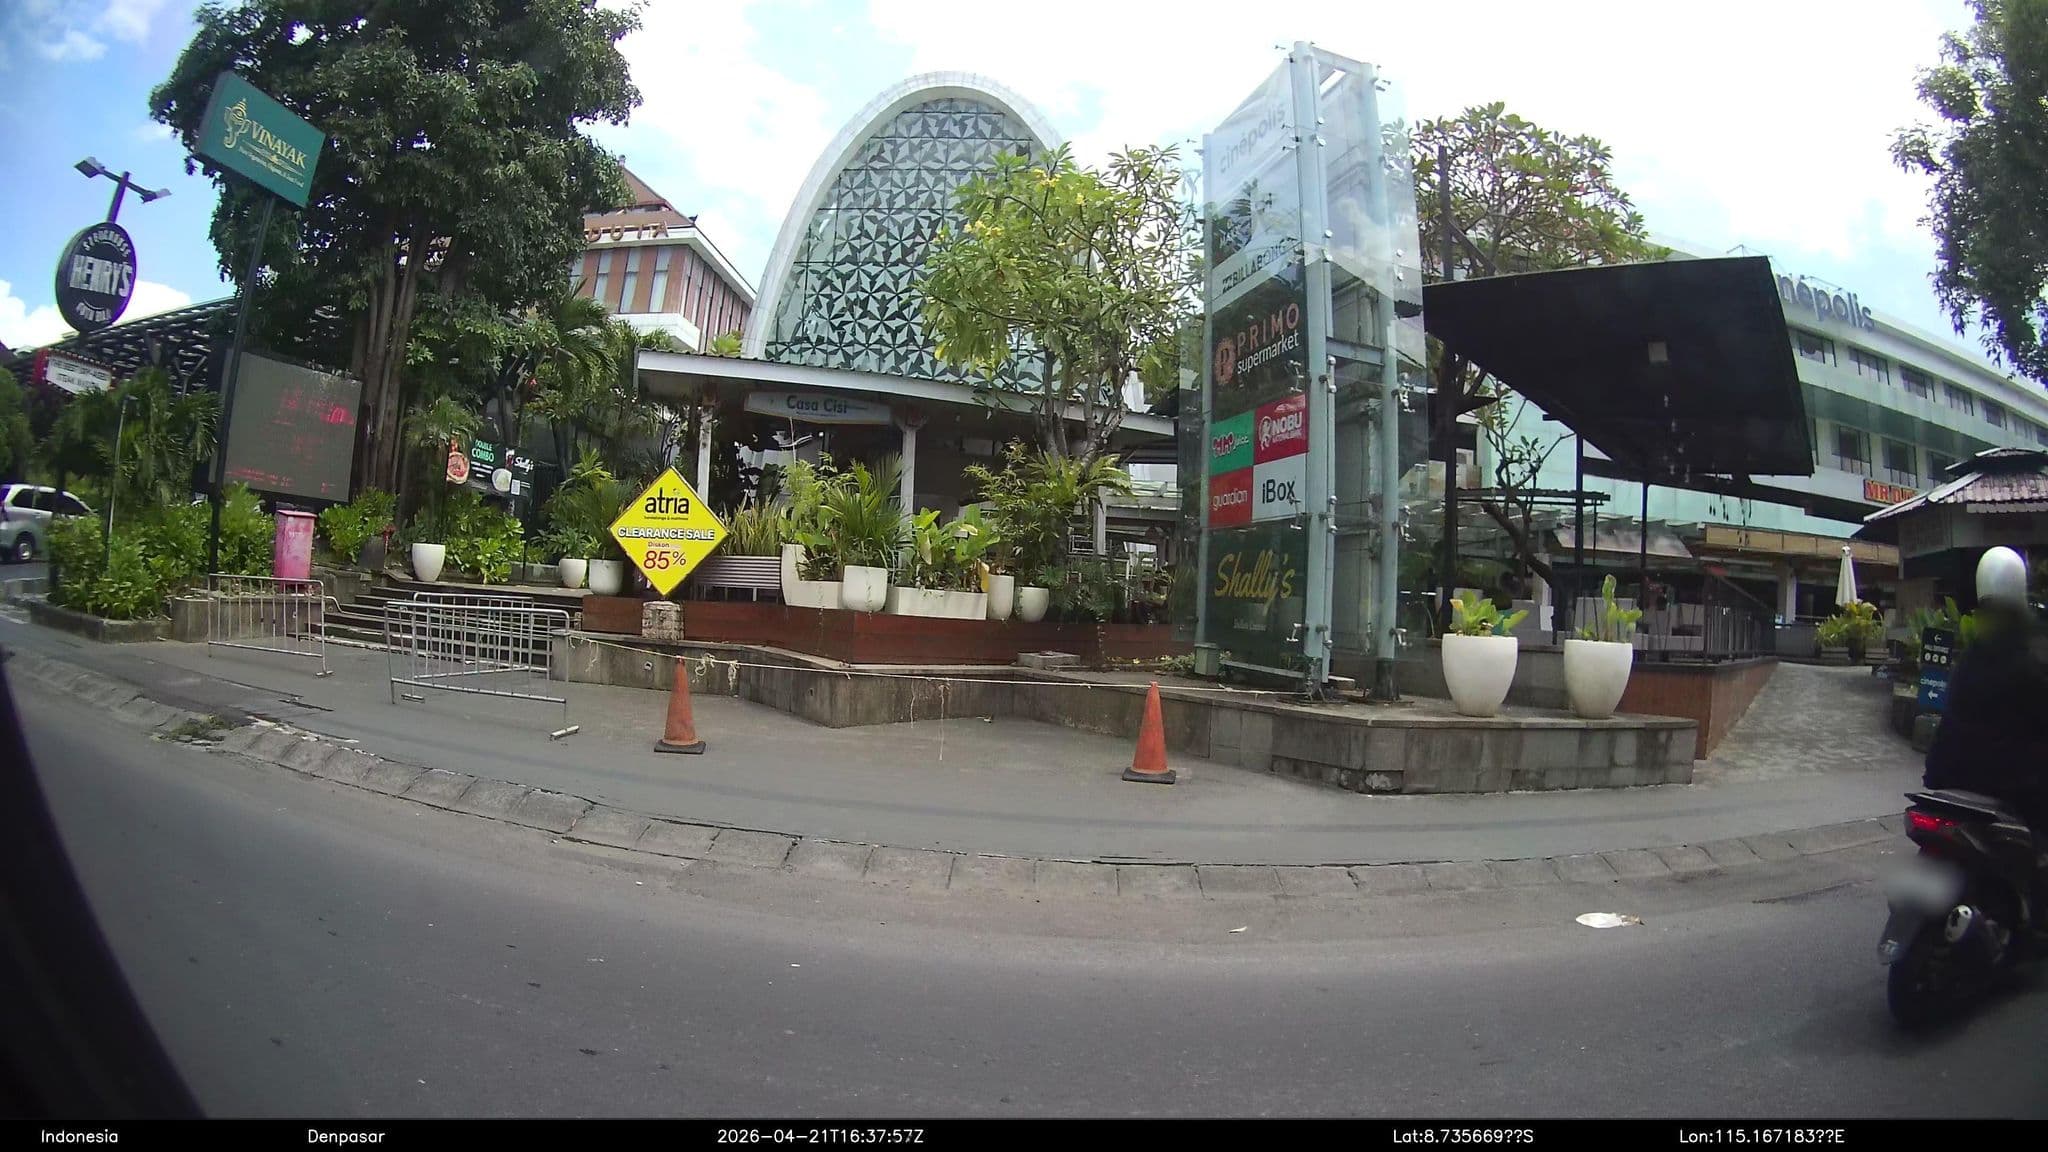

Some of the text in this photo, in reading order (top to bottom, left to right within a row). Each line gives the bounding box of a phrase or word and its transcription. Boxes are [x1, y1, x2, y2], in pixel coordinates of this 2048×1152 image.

[252, 120, 307, 170] VINAYAK
[69, 254, 133, 297] HENRY'S
[1237, 302, 1300, 356] PRIMO
[1237, 329, 1300, 375] supermarket
[1272, 411, 1303, 436] NOBU
[471, 447, 495, 462] COMBO
[645, 487, 690, 515] atria
[1212, 488, 1248, 511] guardian
[1262, 478, 1295, 505] iBox
[618, 527, 715, 541] CLEARANCE SALE
[643, 550, 687, 570] 85%
[1215, 549, 1296, 617] Shally's
